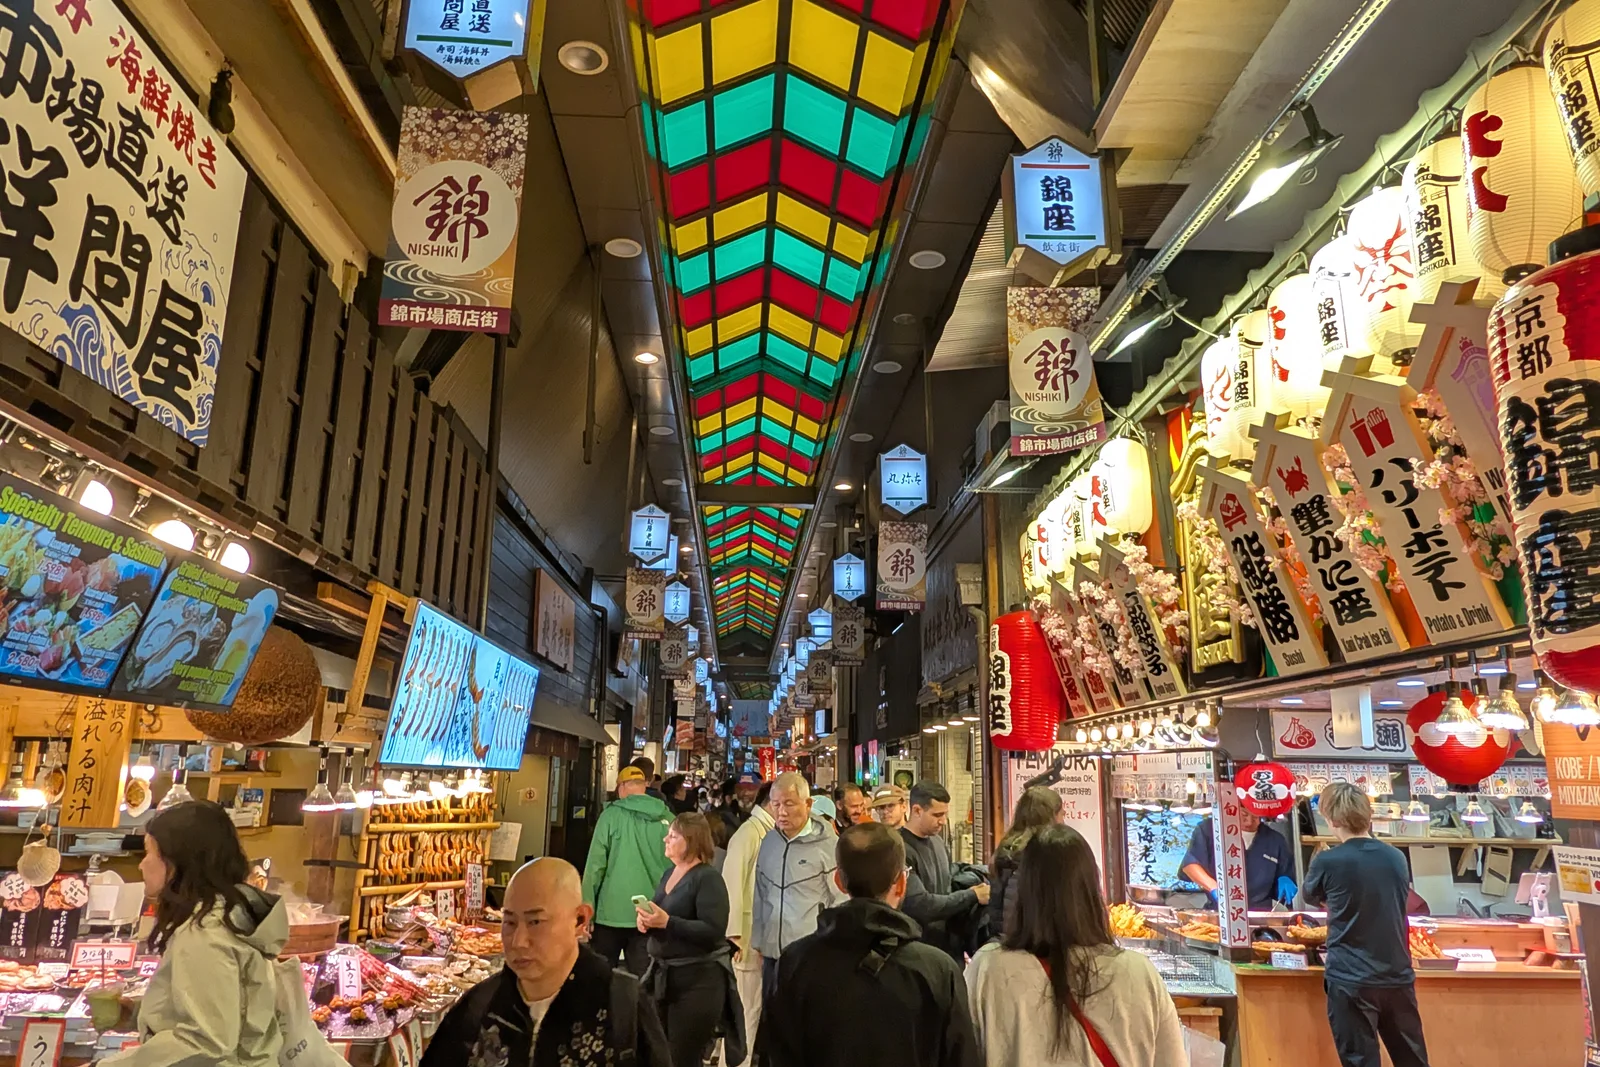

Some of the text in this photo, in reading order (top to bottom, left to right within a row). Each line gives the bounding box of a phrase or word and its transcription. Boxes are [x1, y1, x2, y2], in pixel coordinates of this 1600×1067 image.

[106, 25, 218, 190] 海鮮焼き
[1040, 175, 1076, 231] 錦座
[413, 174, 490, 263] 錦
[407, 242, 459, 258] NISHIKI
[1042, 241, 1080, 253] 飲食街
[1415, 204, 1445, 267] 錦座
[390, 303, 499, 329] 錦市場商店街
[1514, 294, 1553, 381] 京都
[1024, 337, 1080, 404] 錦
[1024, 391, 1062, 402] NISHIKI
[1020, 428, 1098, 453] 錦市場商店街
[1504, 376, 1600, 640] 錦座
[0, 485, 65, 530] Specialty
[61, 511, 116, 549] Tempura
[112, 535, 123, 554] &
[123, 536, 165, 569] Sashimi
[885, 548, 915, 584] 錦
[632, 589, 656, 619] 錦
[1425, 604, 1493, 634] Potato & Drink
[837, 624, 858, 648] 錦
[664, 643, 682, 665] 錦
[1282, 648, 1306, 667] Sushi
[68, 699, 107, 824] 溢れる肉汁
[1555, 757, 1585, 780] KOBE
[1252, 801, 1282, 810] TEMPURA
[1224, 801, 1247, 943] 旬の食材盛沢山
